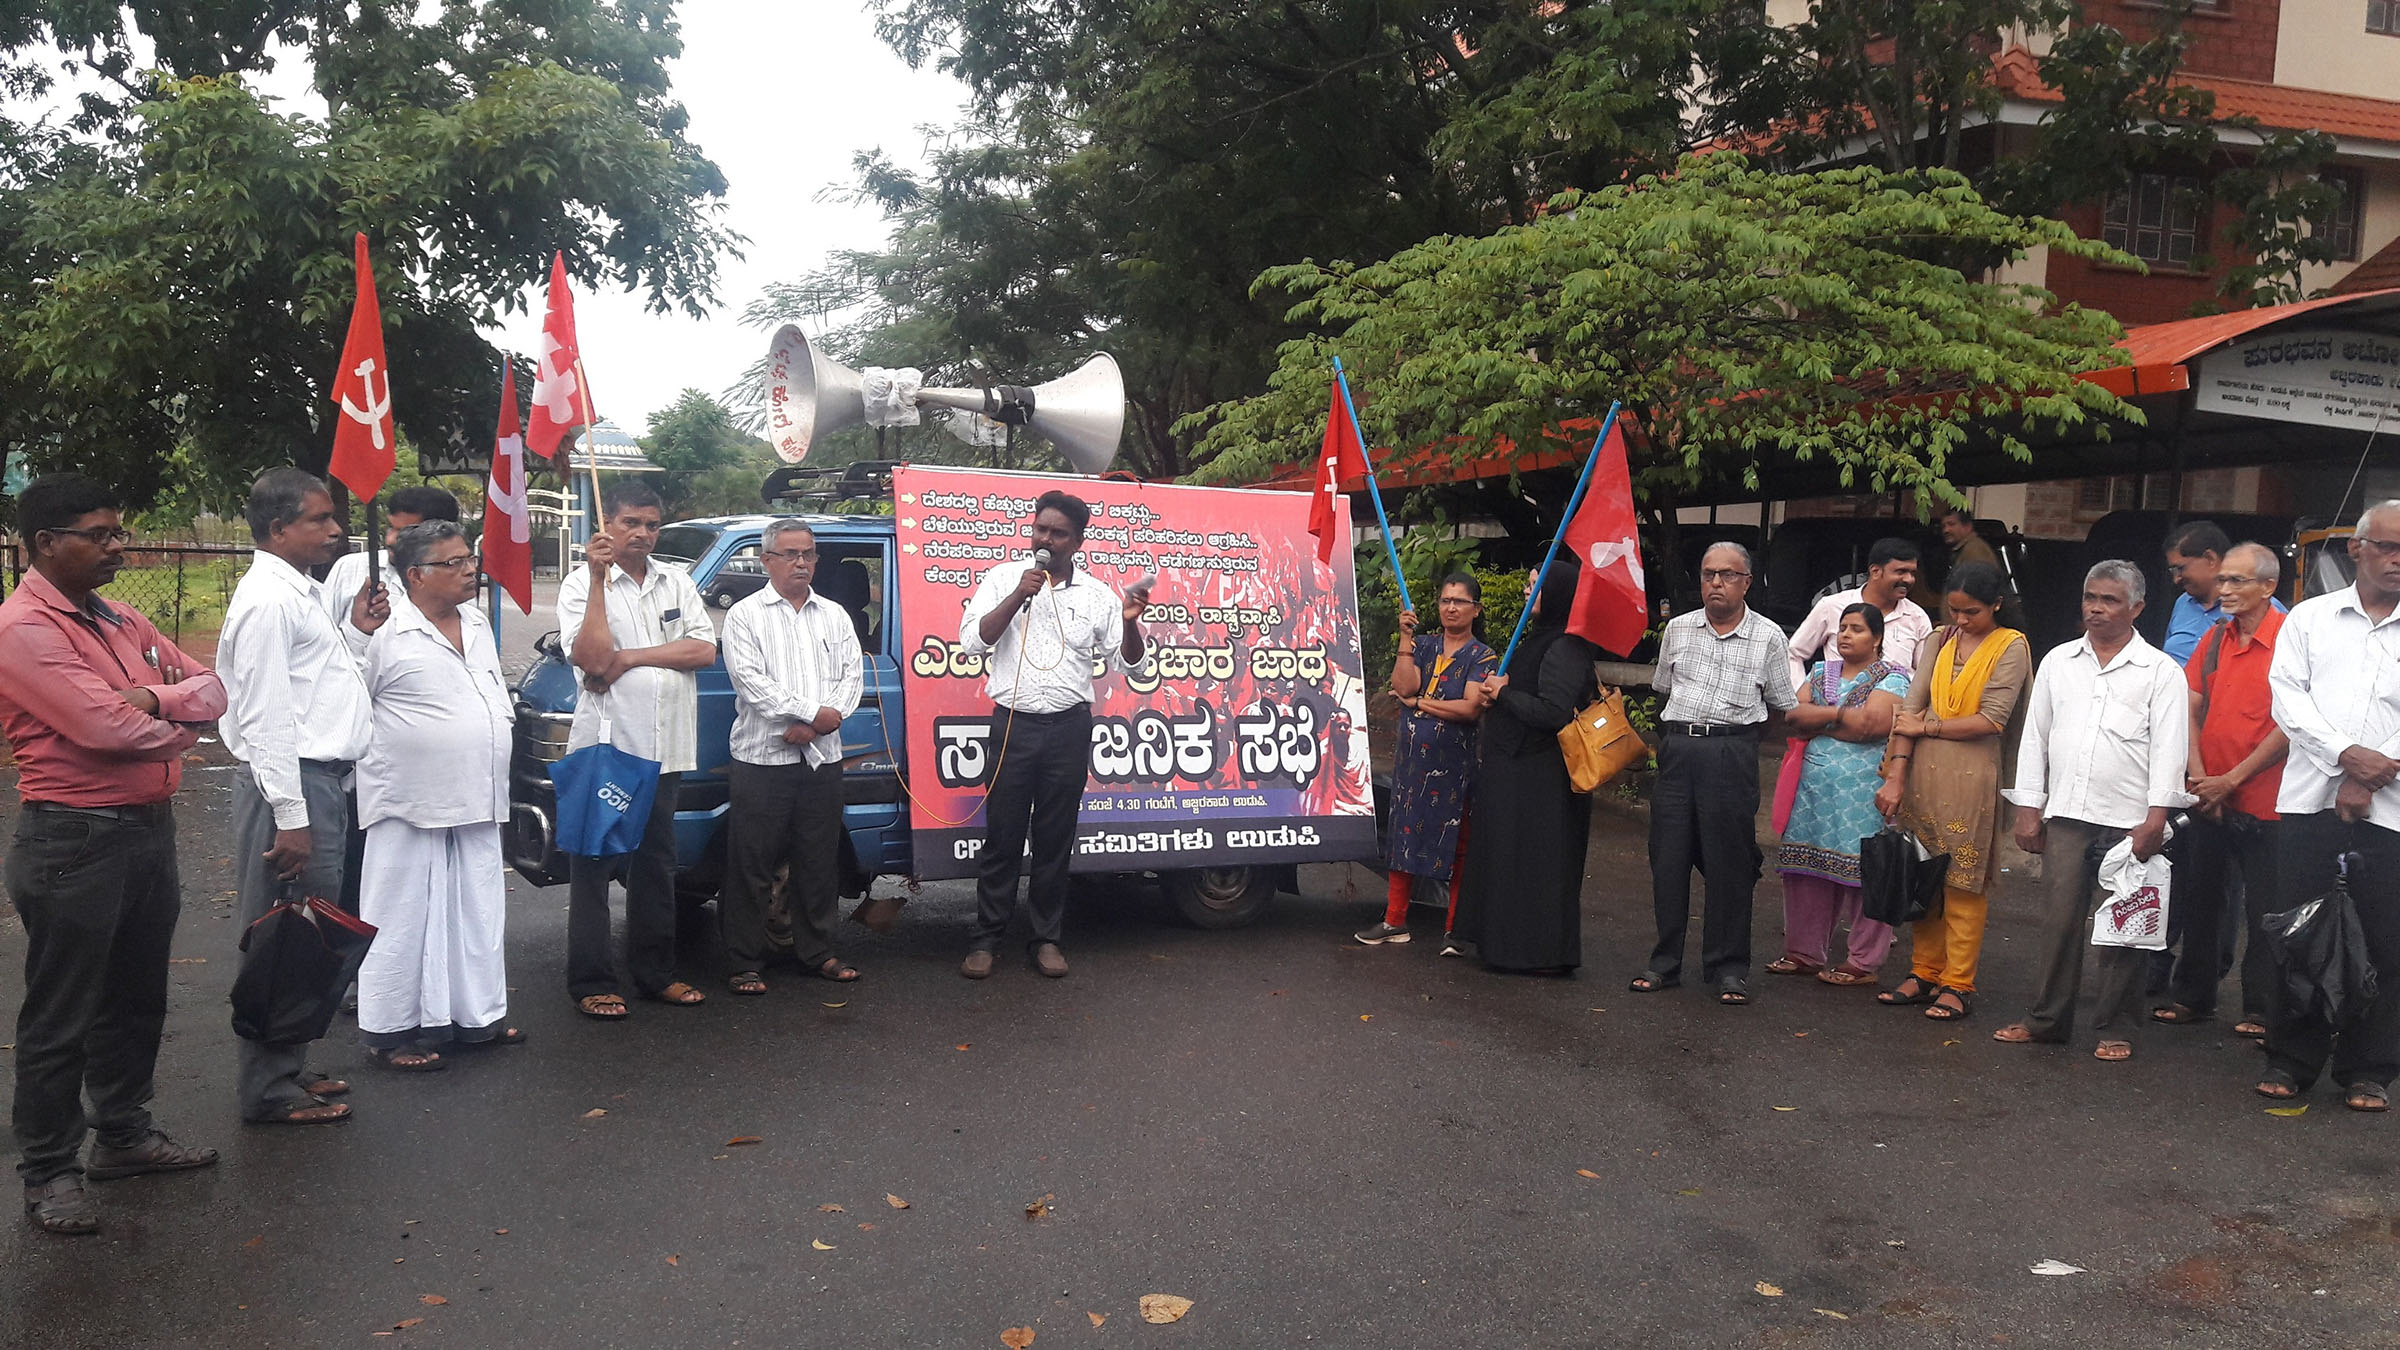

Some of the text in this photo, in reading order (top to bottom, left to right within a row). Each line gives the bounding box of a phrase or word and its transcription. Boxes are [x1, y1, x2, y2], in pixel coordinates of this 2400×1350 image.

[922, 491, 979, 515] ದೇಶದಲ್ಲಿ
[923, 517, 1015, 539] ಬೆಳೆಯುತ್ತಿರುವ
[1083, 526, 1129, 548] ಸಂಕಷ್ಟ
[1134, 529, 1203, 546] ಪರಿಹರಿಸಲು
[923, 541, 1005, 560] ನೆರೆಪರಿಹಾರ
[1091, 551, 1155, 574] ರಾಜ್ಯವನ್ನು
[1159, 554, 1258, 575] ಕಡೆಗಣಿಸುತ್ತಿರುವ
[925, 566, 971, 587] ಕೇಂದ್ರ
[1143, 605, 1282, 638] 2019, ರಾಷ್ಟ್ರವ್ಯಾಪಿ
[1251, 639, 1327, 686] ಜಾಥ
[1238, 704, 1317, 784] ಸಭೆ
[605, 781, 632, 801] CEMENT
[1088, 797, 1112, 811] ಸಂಜೆ
[1117, 798, 1140, 810] 4.30
[1145, 796, 1178, 810] ಗಂಟೆಗೆ,
[1182, 795, 1229, 814] ಅಜ್ಜರಕಾಡು
[1233, 794, 1267, 807] ಉಡುಪಿ.
[1078, 828, 1213, 854] ಸಮಿತಿಗಳು
[1226, 824, 1321, 848] ಉಡುಪಿ
